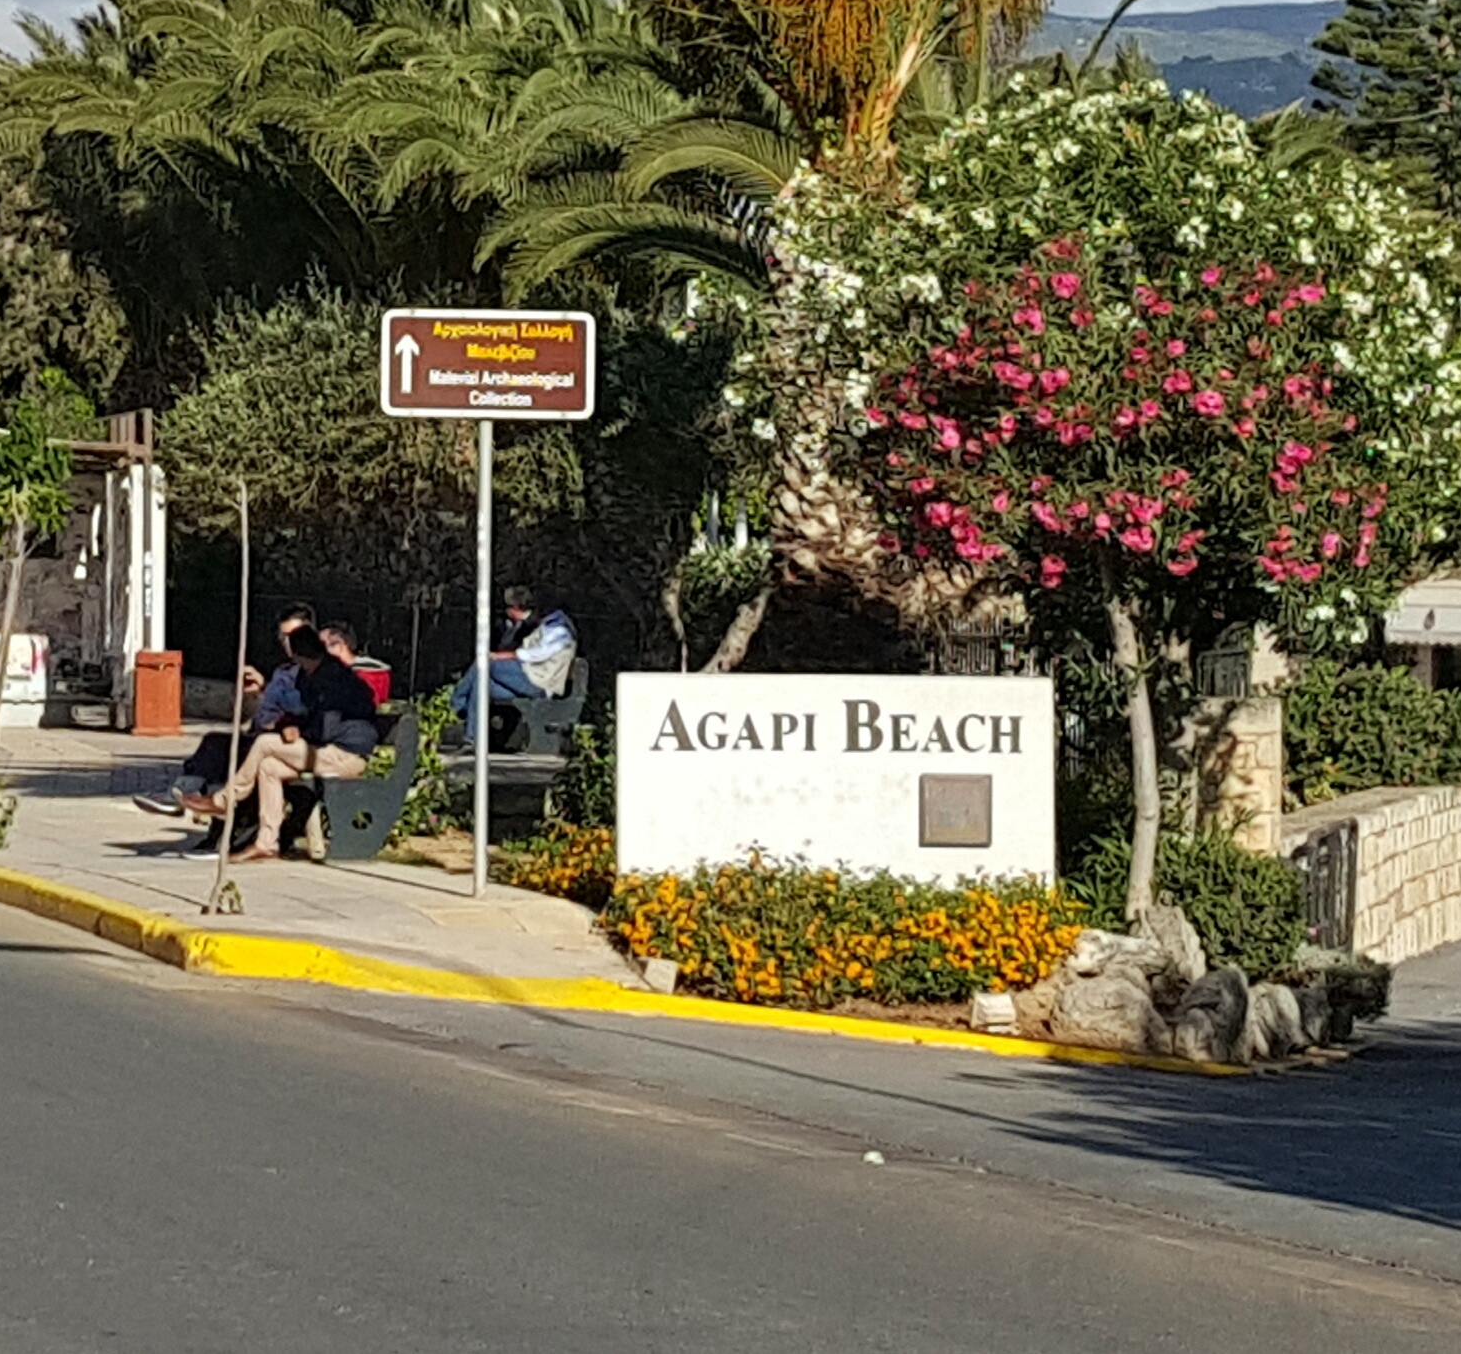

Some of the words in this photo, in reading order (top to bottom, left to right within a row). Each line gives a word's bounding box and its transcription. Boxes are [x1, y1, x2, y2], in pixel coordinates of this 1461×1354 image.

[468, 390, 533, 407] Collection
[649, 698, 817, 752] AGAPI
[841, 698, 1024, 754] BEACH
